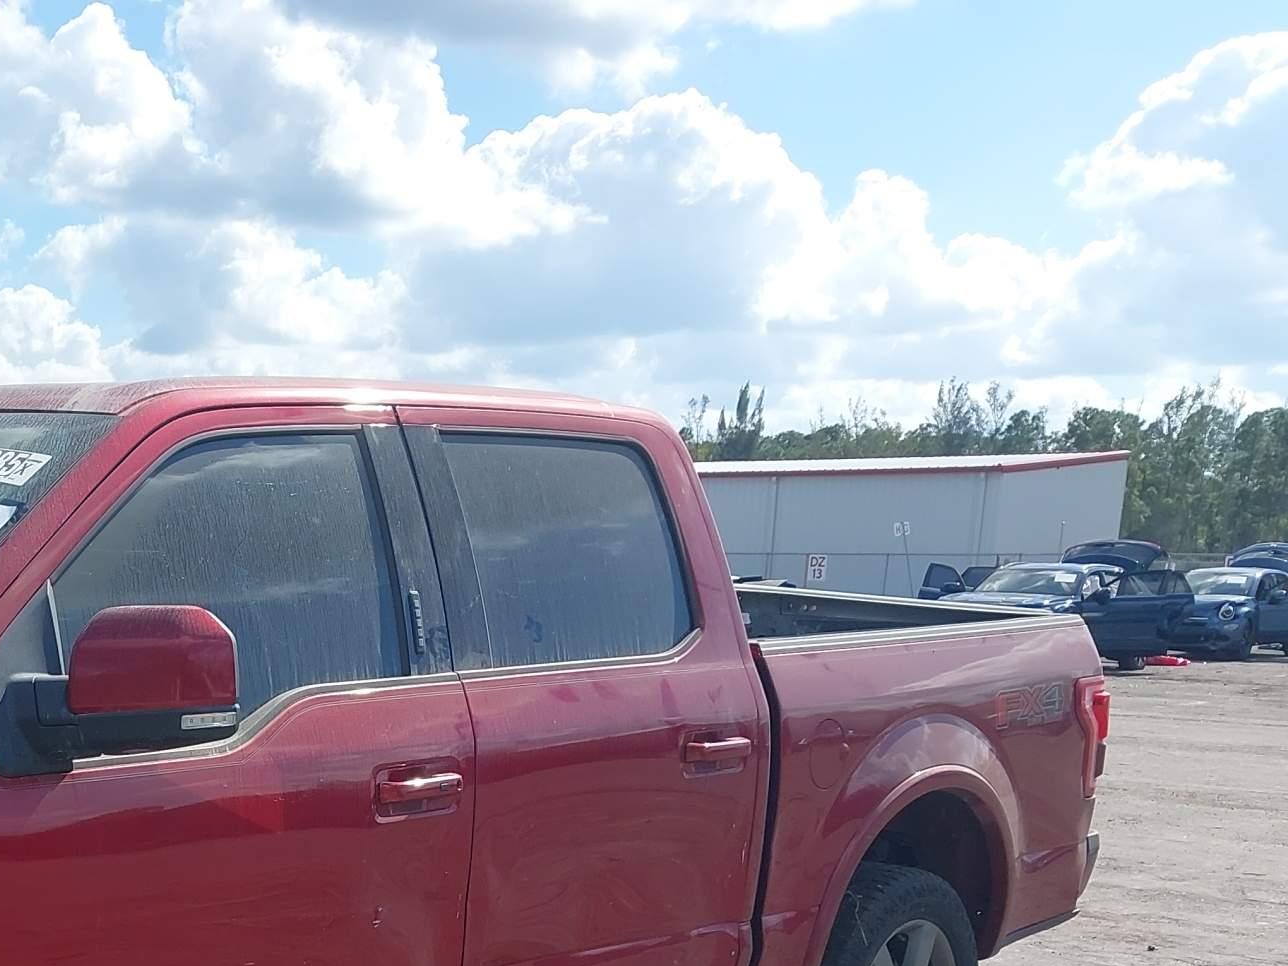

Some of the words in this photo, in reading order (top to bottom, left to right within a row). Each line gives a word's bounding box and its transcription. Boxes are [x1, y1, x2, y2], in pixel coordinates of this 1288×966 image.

[810, 556, 826, 568] DZ
[812, 568, 823, 579] 13
[995, 681, 1064, 730] FX4
